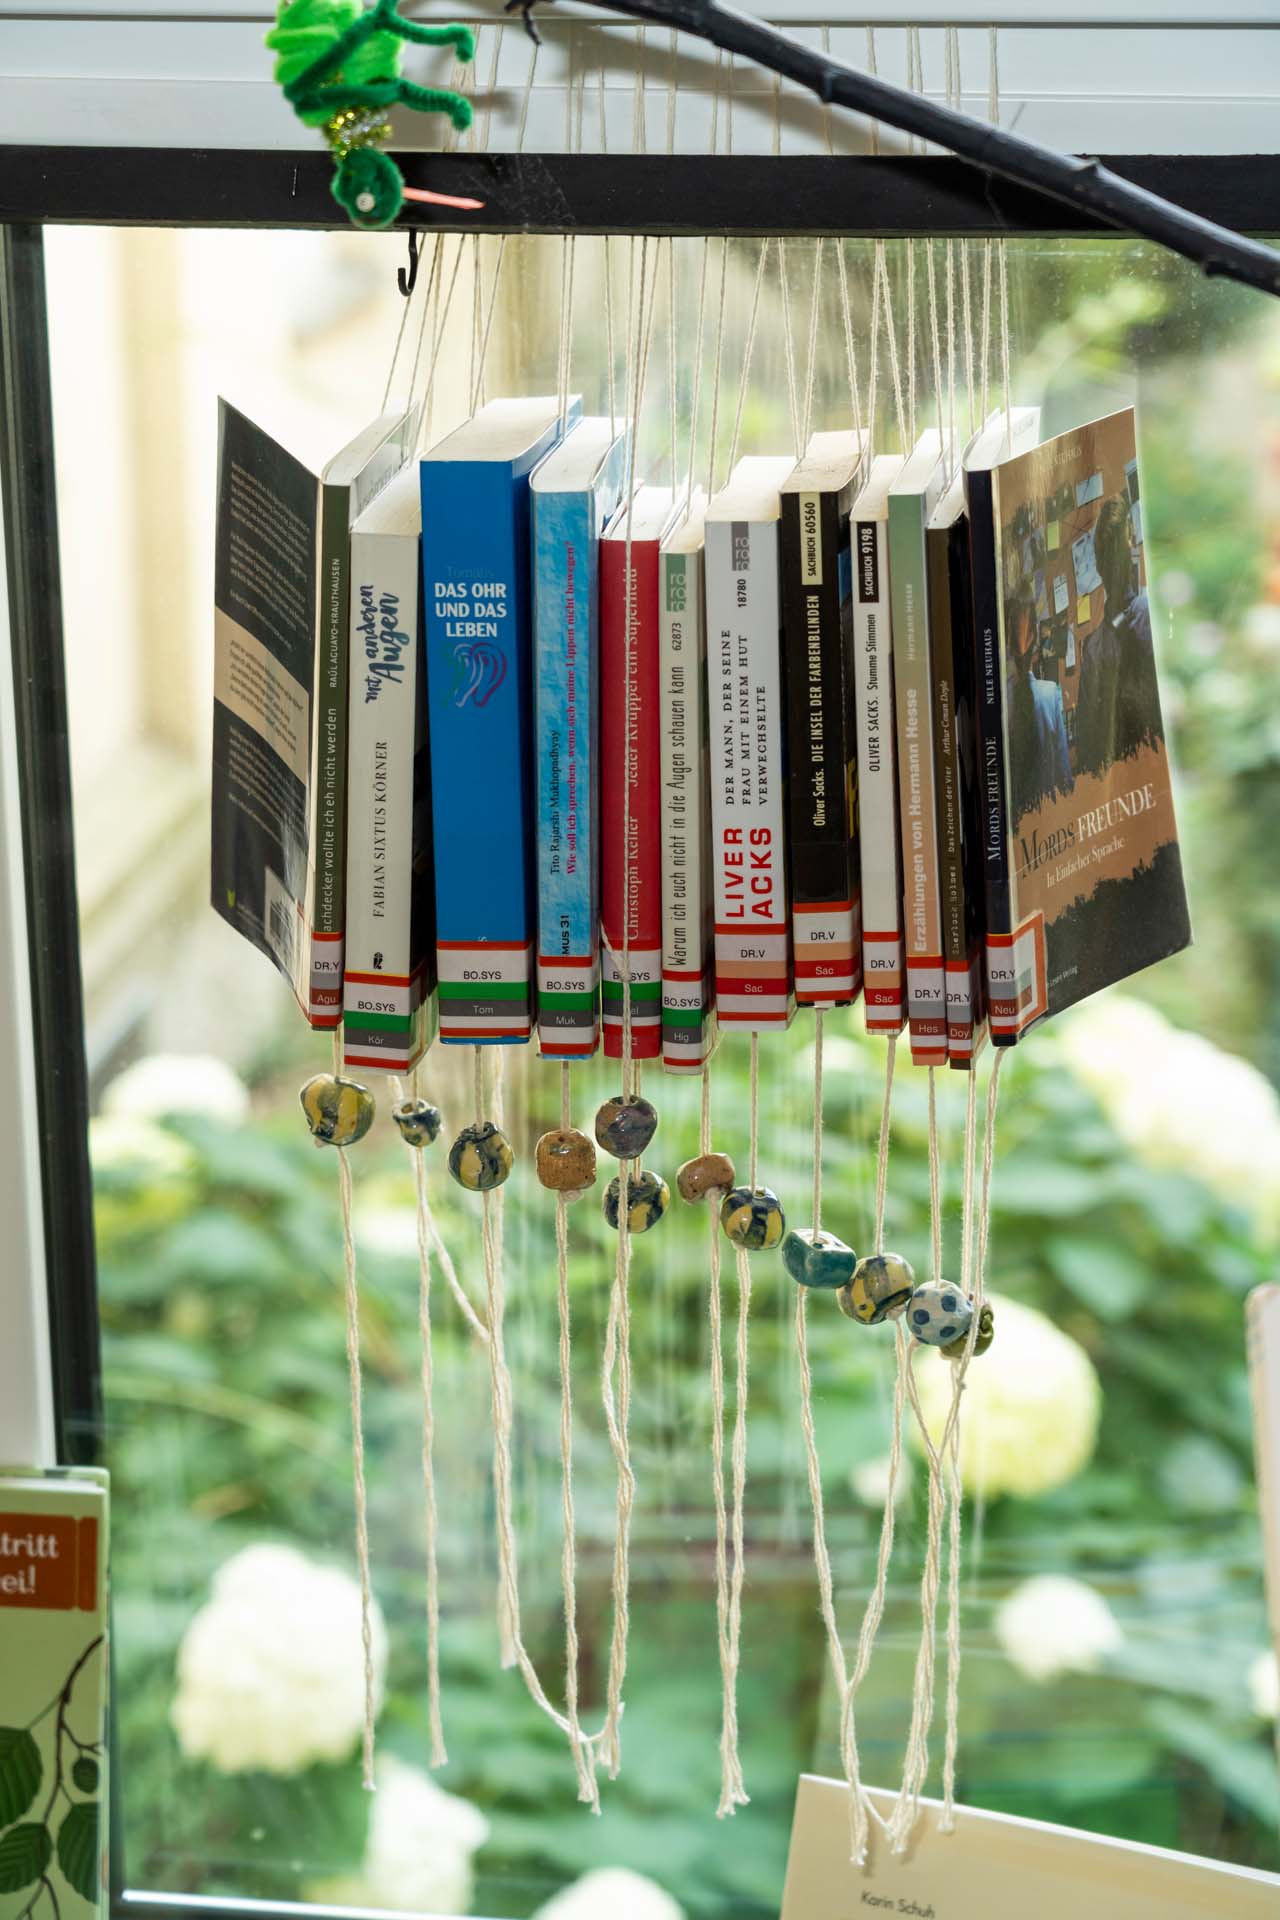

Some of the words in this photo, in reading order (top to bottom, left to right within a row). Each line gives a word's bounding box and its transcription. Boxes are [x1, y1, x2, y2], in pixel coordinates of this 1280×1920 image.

[804, 502, 816, 534] 60560
[861, 528, 873, 554] 9198
[806, 537, 817, 577] SACHBUCH
[863, 556, 874, 596] SACHBUCH
[434, 582, 467, 598] DAS
[471, 582, 507, 599] OHR
[737, 579, 747, 607] 18780
[329, 558, 341, 665] AGUAYO-KRAUTHAUSEN
[355, 585, 379, 659] anderen
[435, 602, 470, 618] UND
[474, 602, 507, 618] DAS
[565, 598, 576, 625] nicht
[368, 592, 410, 684] Augen
[446, 622, 497, 637] LEBEN
[671, 622, 682, 652] 62873
[806, 595, 822, 682] FARBENBLINDEN
[865, 614, 877, 653] Stimmen
[565, 628, 577, 667] Lippen
[721, 629, 731, 676] SEINE
[737, 634, 748, 667] HUT
[983, 627, 993, 676] NEUHAUS
[327, 665, 339, 688] RAÚL
[667, 666, 685, 695] kann
[866, 655, 878, 690] Stumme
[722, 682, 732, 712] DER
[738, 675, 750, 724] EINEM
[809, 686, 822, 706] DER
[985, 678, 995, 704] NELE
[565, 705, 576, 727] sich
[667, 700, 685, 747] schauen
[810, 710, 823, 740] INSEL
[867, 697, 880, 731] SACKS.
[905, 688, 919, 738] Hesse
[324, 708, 337, 754] werden
[566, 729, 576, 757] wenn
[723, 719, 734, 769] MANN,
[740, 731, 750, 760] MIT
[755, 685, 768, 806] VERWECHSELTE
[811, 744, 824, 762] DIE
[868, 737, 881, 772] OLIVER
[323, 757, 336, 789] nicht
[372, 740, 388, 803] KÖRNER
[548, 729, 562, 808] Mukhopadhyay
[665, 753, 692, 790] Augen
[811, 768, 825, 797] Sacks.
[908, 743, 922, 816] Hermann
[944, 766, 953, 784] Vier
[985, 736, 999, 802] FREUNDE
[323, 792, 336, 807] eh
[725, 776, 735, 805] DER
[741, 767, 751, 805] FRAU
[944, 785, 953, 800] der
[667, 795, 685, 813] die
[812, 799, 826, 826] Oliver
[1077, 783, 1157, 843] FREUNDE
[322, 810, 335, 828] ich
[550, 810, 561, 852] Rajarshi
[566, 812, 576, 830] ich
[668, 818, 686, 829] in
[373, 807, 387, 860] SIXTUS
[566, 833, 576, 851] soll
[911, 821, 923, 849] von
[322, 831, 335, 869] wollte
[566, 853, 577, 875] Wie
[667, 835, 686, 866] nicht
[550, 855, 560, 875] Tito
[723, 828, 745, 917] LIVER
[749, 827, 773, 918] ACKS
[372, 865, 385, 918] FABIAN
[668, 872, 686, 898] euch
[321, 872, 334, 932] achdecker
[668, 904, 686, 920] ich
[912, 854, 927, 952] Erzählungen
[560, 915, 570, 928] 31
[561, 931, 570, 955] MUS
[668, 927, 687, 966] Warum
[810, 931, 836, 941] DR.V
[314, 961, 340, 970] DR.Y
[740, 949, 766, 959] DR.V
[870, 959, 896, 969] DR.V
[463, 970, 502, 980] BO.SYS
[612, 971, 651, 981] BSYS
[815, 966, 834, 975] Sac
[991, 969, 1016, 980] DR.Y
[316, 994, 336, 1004] Agu
[546, 981, 585, 991] BO.SYS
[744, 984, 763, 993] Sac
[875, 994, 893, 1003] Sac
[914, 989, 941, 999] DR.Y
[946, 993, 971, 1003] DR.Y
[357, 1000, 396, 1013] BO.SYS
[472, 1005, 494, 1015] Tom
[663, 996, 701, 1008] BO.SYS
[994, 1005, 1015, 1015] Neu
[555, 1015, 576, 1025] Muk
[918, 1024, 938, 1033] Hes
[950, 1028, 970, 1039] Doy
[673, 1032, 689, 1043] Hig
[0, 1532, 60, 1559] tritt
[0, 1563, 36, 1594] ei!
[861, 1889, 895, 1910] Karin
[896, 1898, 936, 1920] Schuh
